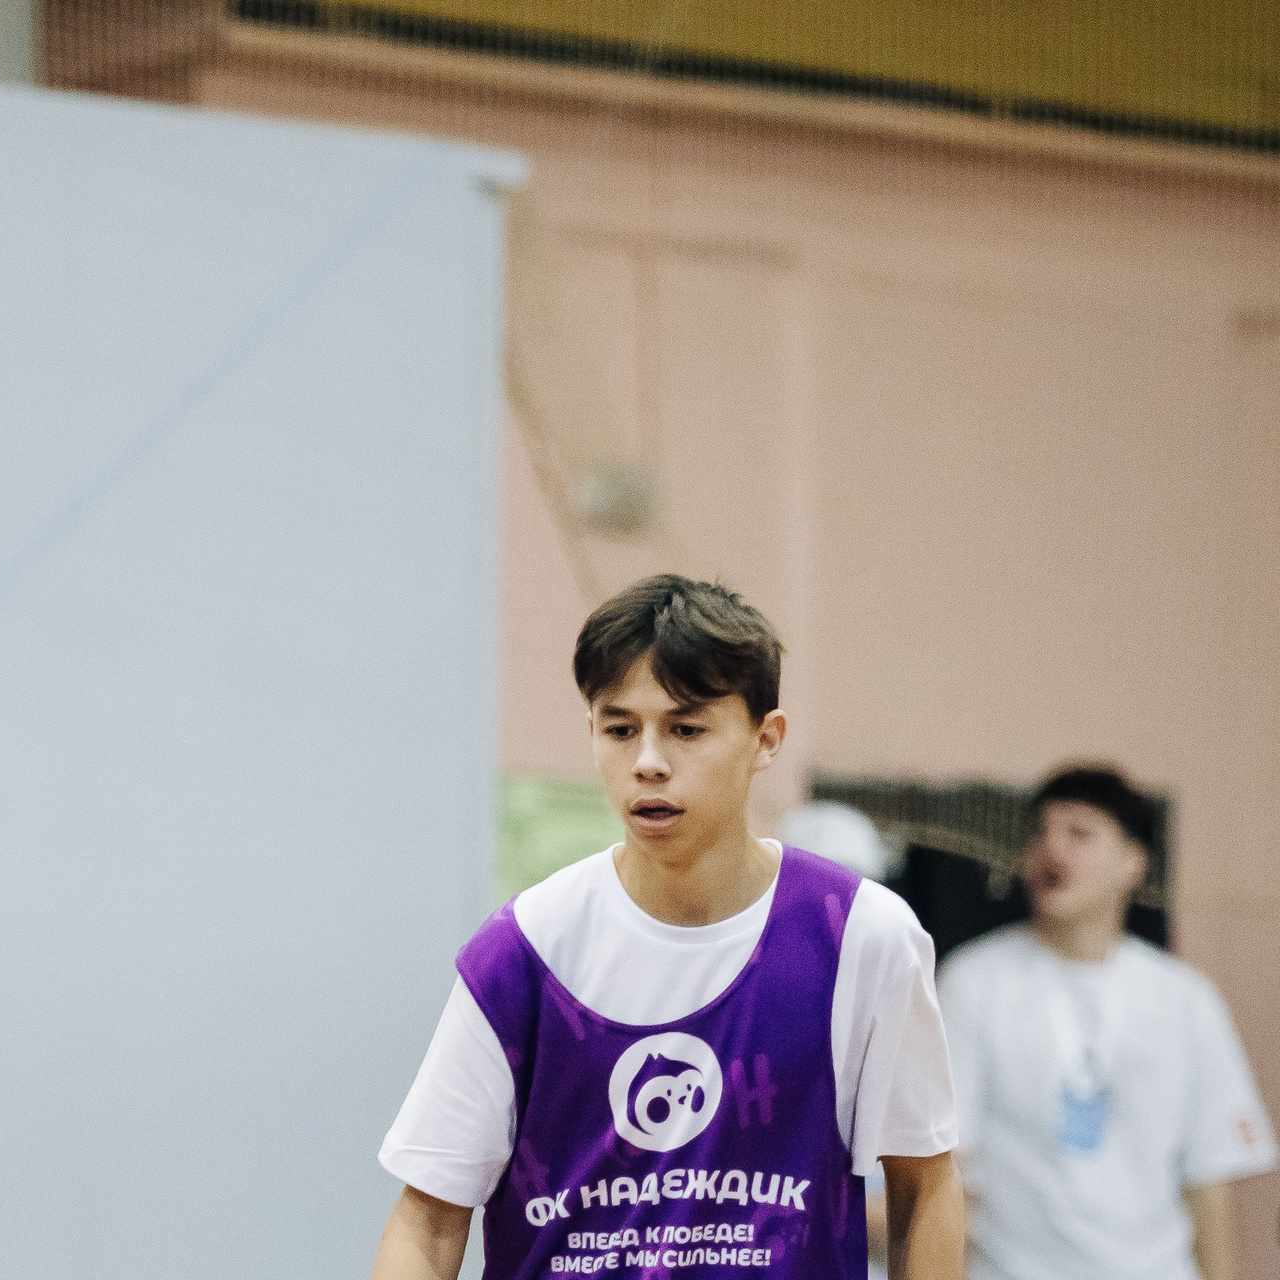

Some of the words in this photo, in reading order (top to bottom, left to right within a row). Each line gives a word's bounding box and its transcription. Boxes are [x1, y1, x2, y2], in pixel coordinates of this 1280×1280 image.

[525, 1188, 571, 1227] ФК
[580, 1168, 812, 1211] НАДЕЖДИК
[625, 1249, 661, 1268] МЫ
[662, 1247, 772, 1268] СИЛЬНЕЕ!
